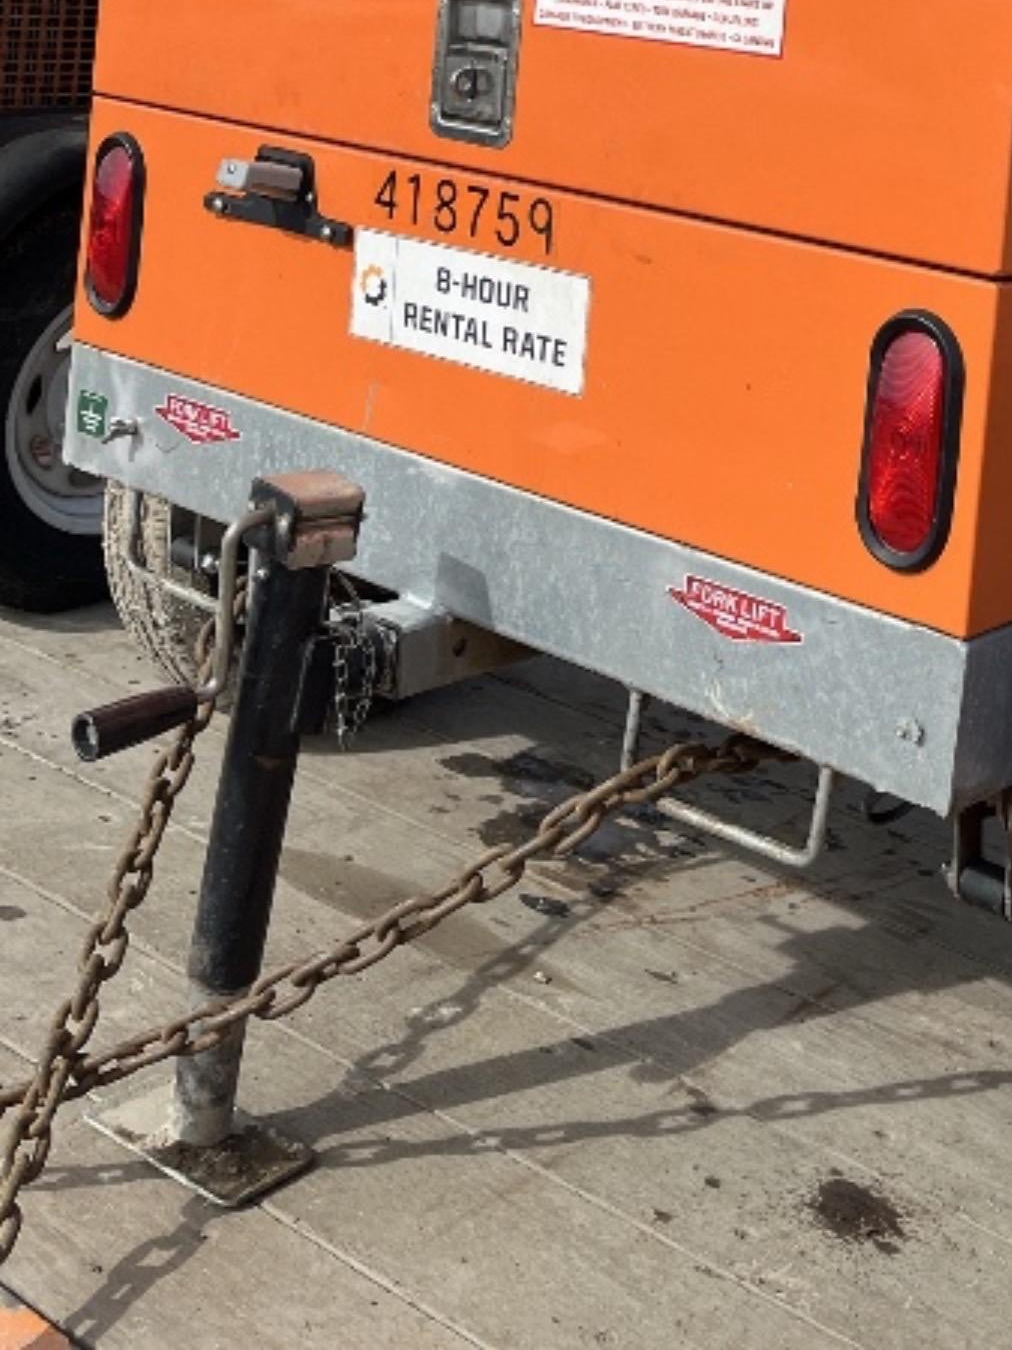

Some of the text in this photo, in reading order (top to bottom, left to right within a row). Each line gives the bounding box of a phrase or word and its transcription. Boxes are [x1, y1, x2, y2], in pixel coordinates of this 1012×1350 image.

[374, 170, 553, 255] 418759
[436, 266, 531, 313] 8-HOUR
[403, 301, 568, 368] RENTAL RATE
